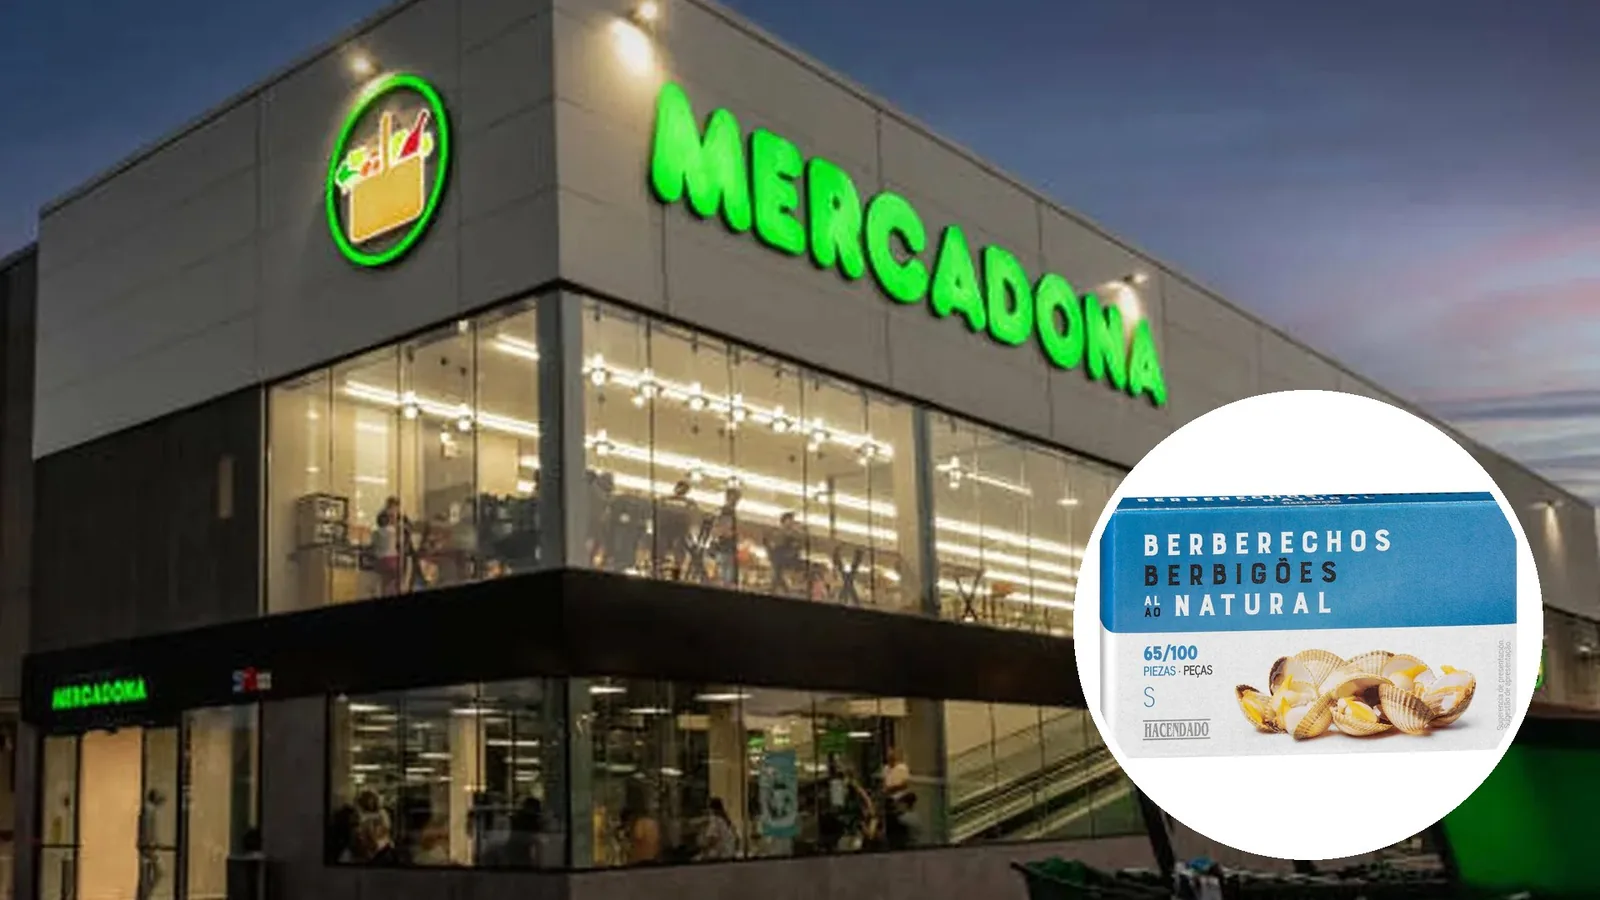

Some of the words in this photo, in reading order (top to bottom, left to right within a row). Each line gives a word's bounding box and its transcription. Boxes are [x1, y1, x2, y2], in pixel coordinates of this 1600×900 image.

[651, 81, 1168, 406] MERCADONA
[1144, 529, 1391, 557] BERBERECHOS
[1144, 557, 1337, 587] BERBIGÕES
[1144, 595, 1160, 606] AL
[1175, 591, 1332, 617] NATURAL
[1144, 607, 1161, 617] AO
[1143, 644, 1198, 662] 65/100
[1143, 666, 1176, 676] PIEZAS
[1183, 665, 1213, 678] PEÇAS
[1143, 686, 1155, 708] S
[1144, 722, 1209, 738] HACENDADO
